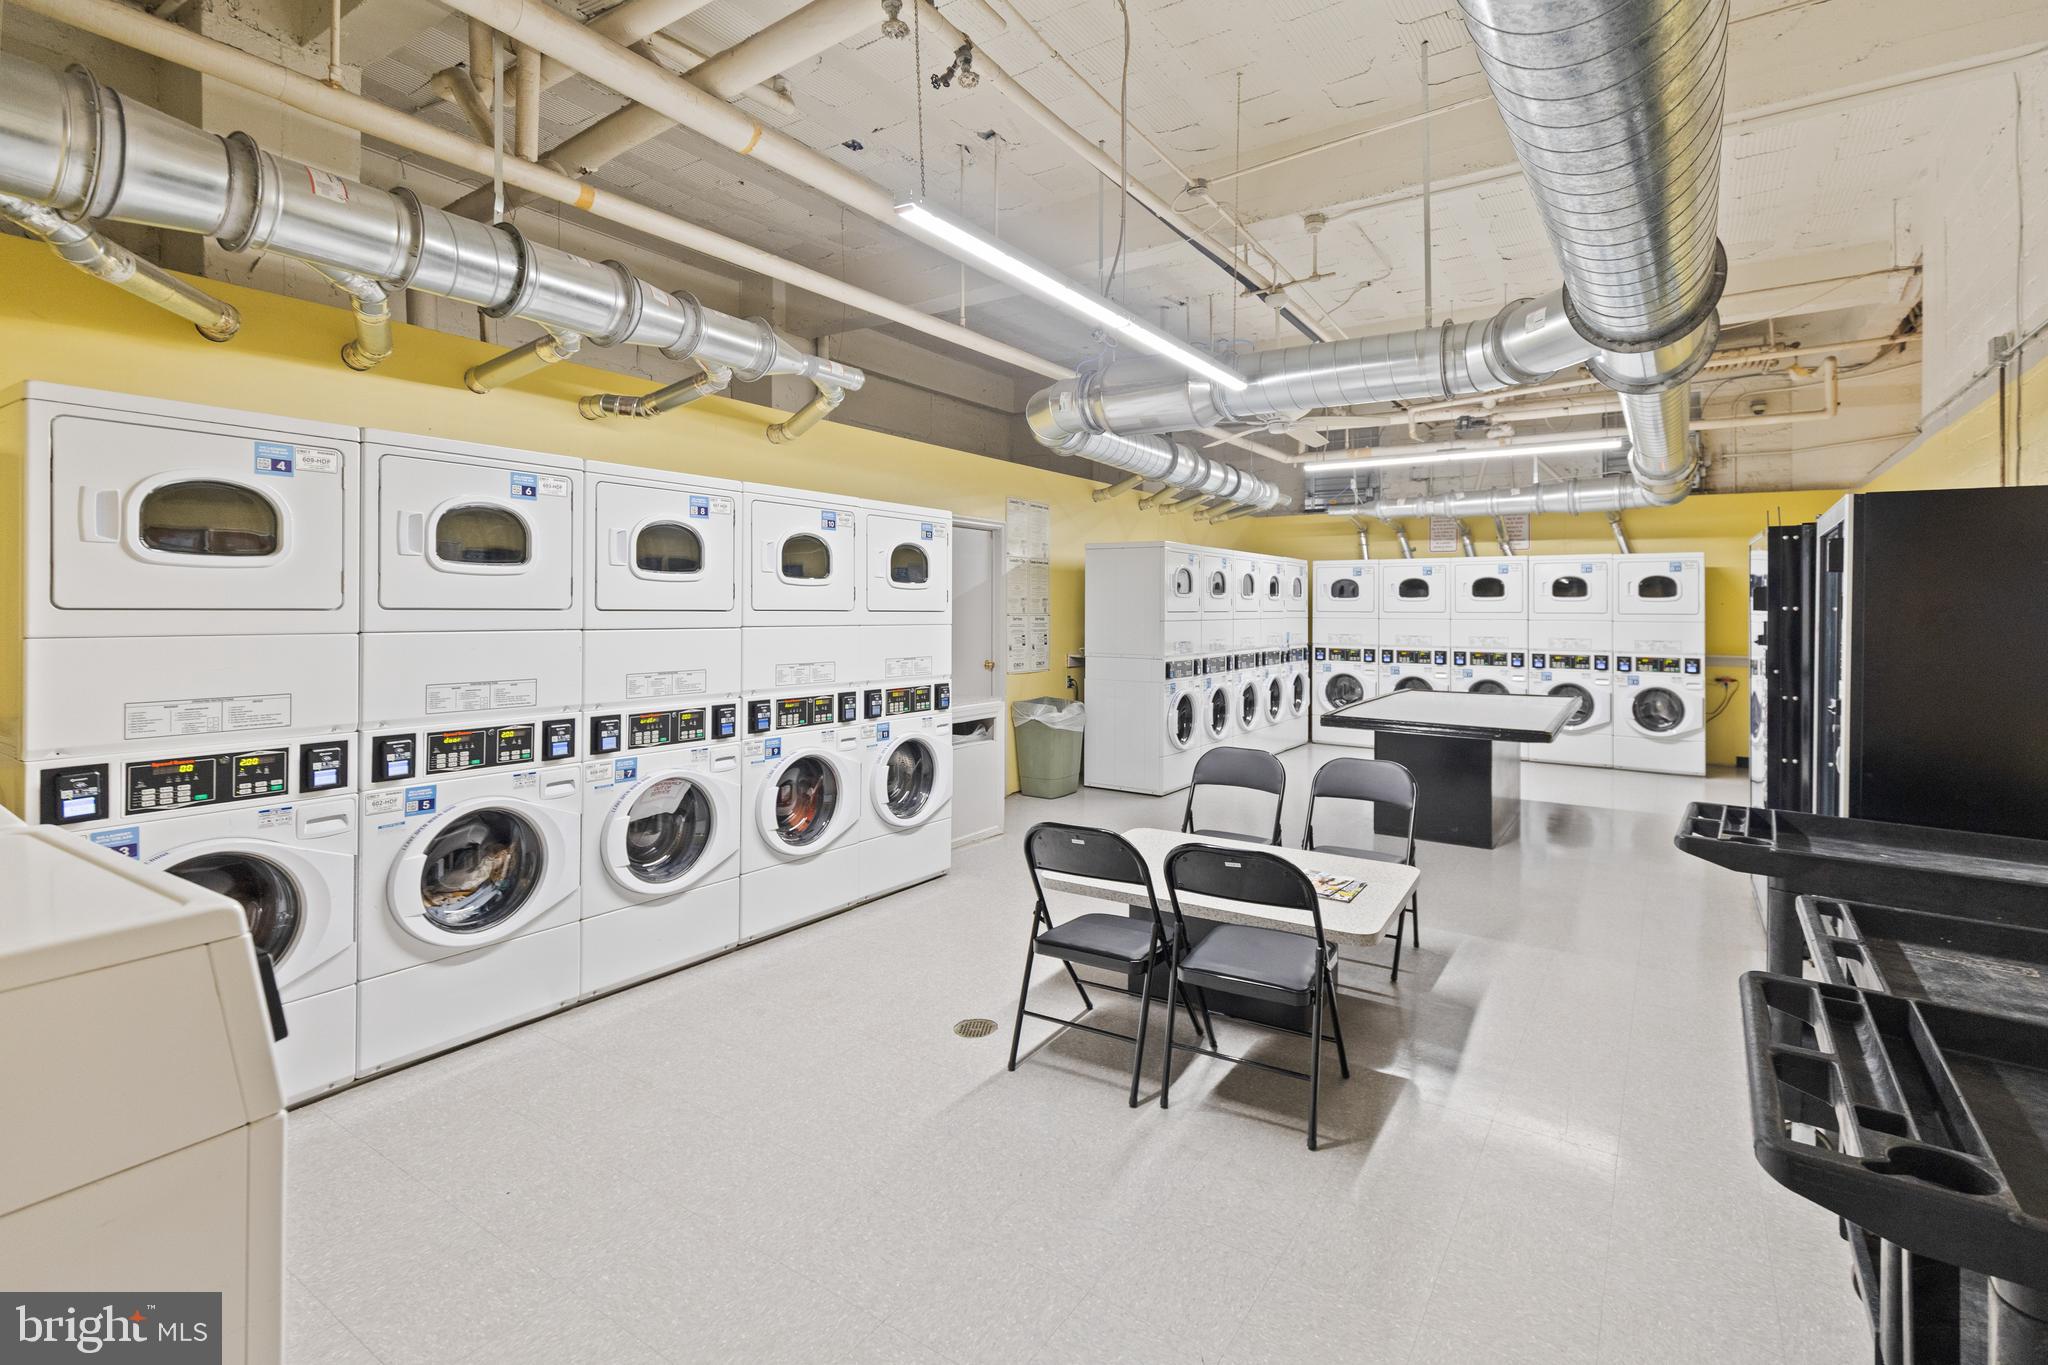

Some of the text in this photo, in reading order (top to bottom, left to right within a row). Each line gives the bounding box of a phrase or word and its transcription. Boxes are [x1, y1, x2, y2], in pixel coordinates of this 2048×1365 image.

[276, 461, 286, 471] 4
[525, 487, 532, 496] 6
[828, 520, 835, 528] 10
[626, 769, 632, 778] 7
[422, 800, 430, 809] 5
[119, 846, 130, 857] 3
